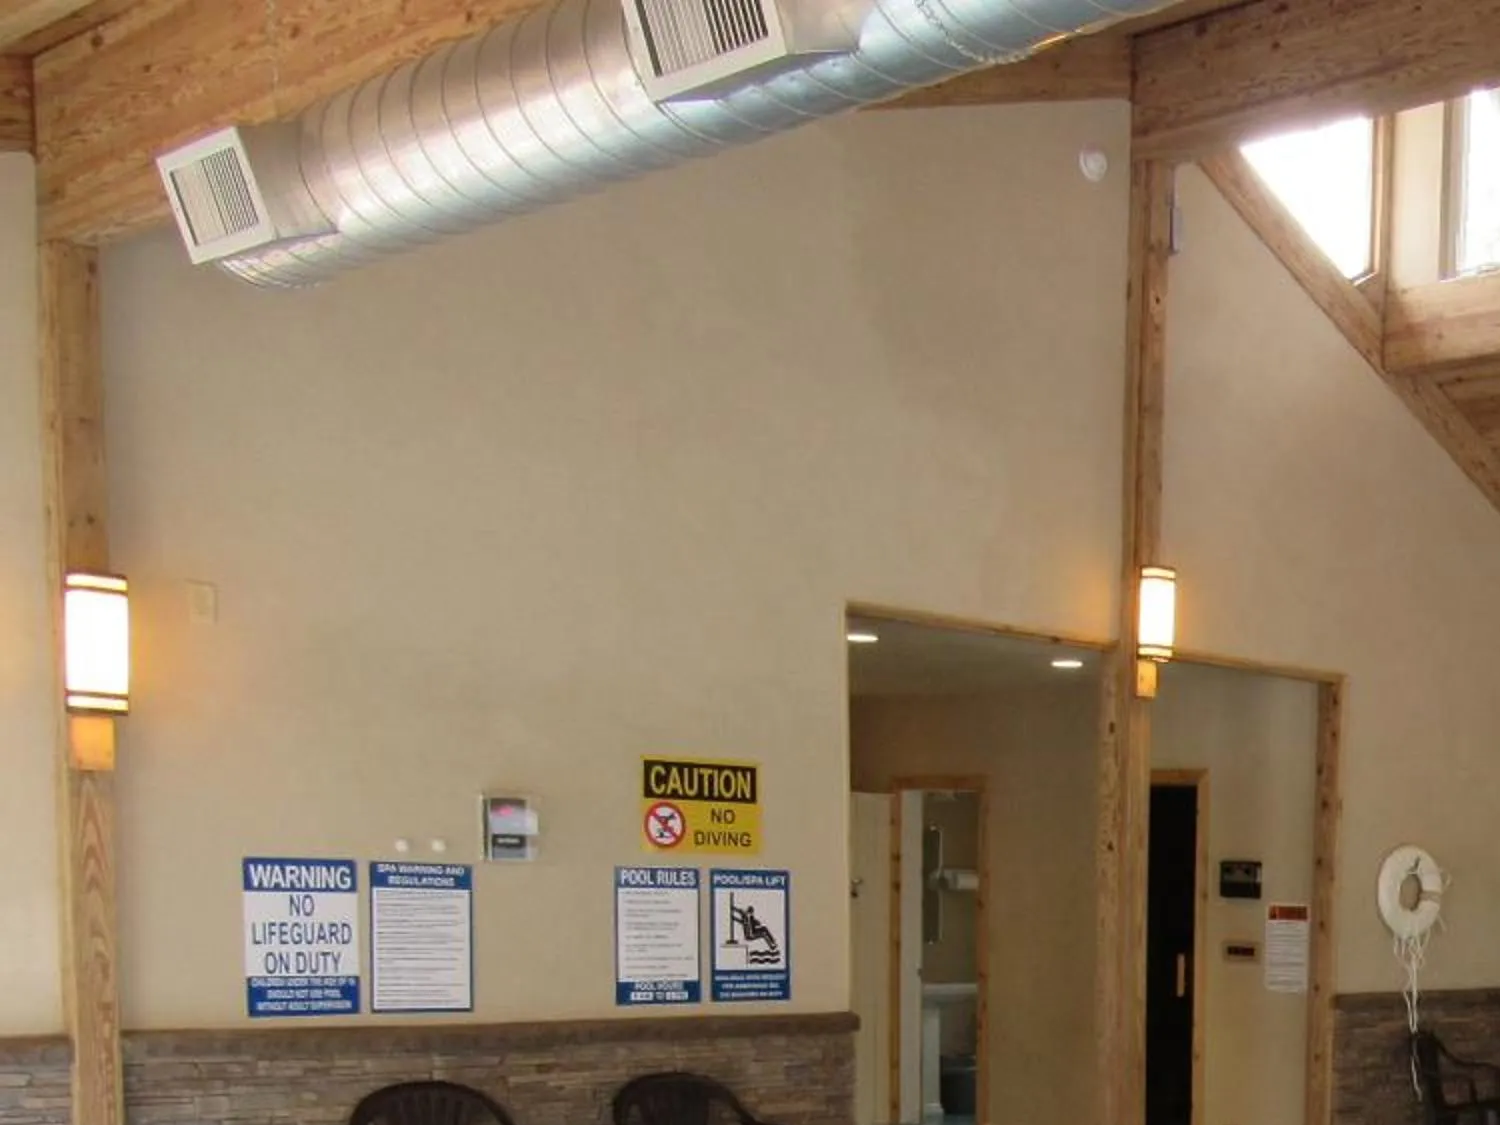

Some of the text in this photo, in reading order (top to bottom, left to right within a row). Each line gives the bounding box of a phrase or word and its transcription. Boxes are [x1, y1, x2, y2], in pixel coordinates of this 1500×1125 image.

[650, 765, 751, 799] CAUTION
[711, 808, 735, 824] NO
[694, 830, 752, 847] DIVING
[249, 863, 351, 889] WARNING
[621, 869, 696, 885] POOL RULES
[766, 875, 785, 886] LIFT
[289, 894, 315, 916] NO
[252, 922, 352, 945] LIFEGUARD
[264, 951, 341, 974] ON DUTY
